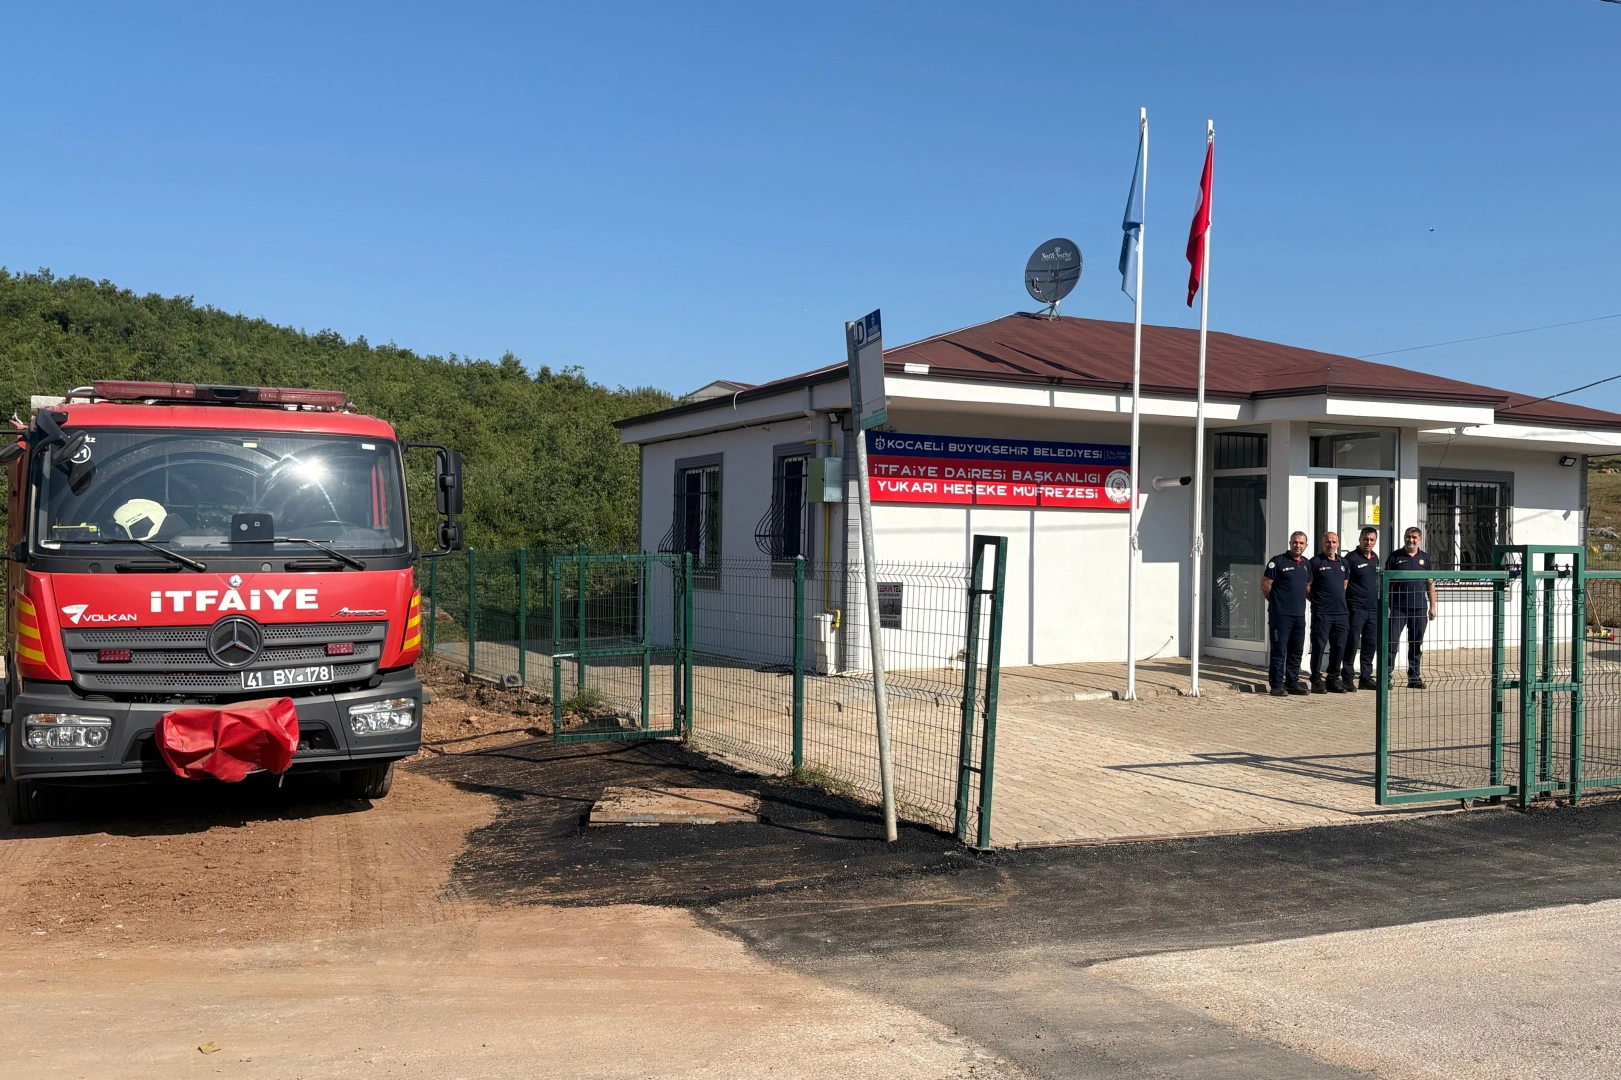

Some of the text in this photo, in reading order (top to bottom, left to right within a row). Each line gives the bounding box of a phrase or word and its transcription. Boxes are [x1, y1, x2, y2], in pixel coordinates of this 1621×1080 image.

[856, 321, 865, 346] D
[877, 480, 937, 493] YUKARI
[943, 483, 1008, 496] HEREKE
[82, 613, 137, 622] VOLKAN
[247, 666, 329, 687] 41 BY 178
